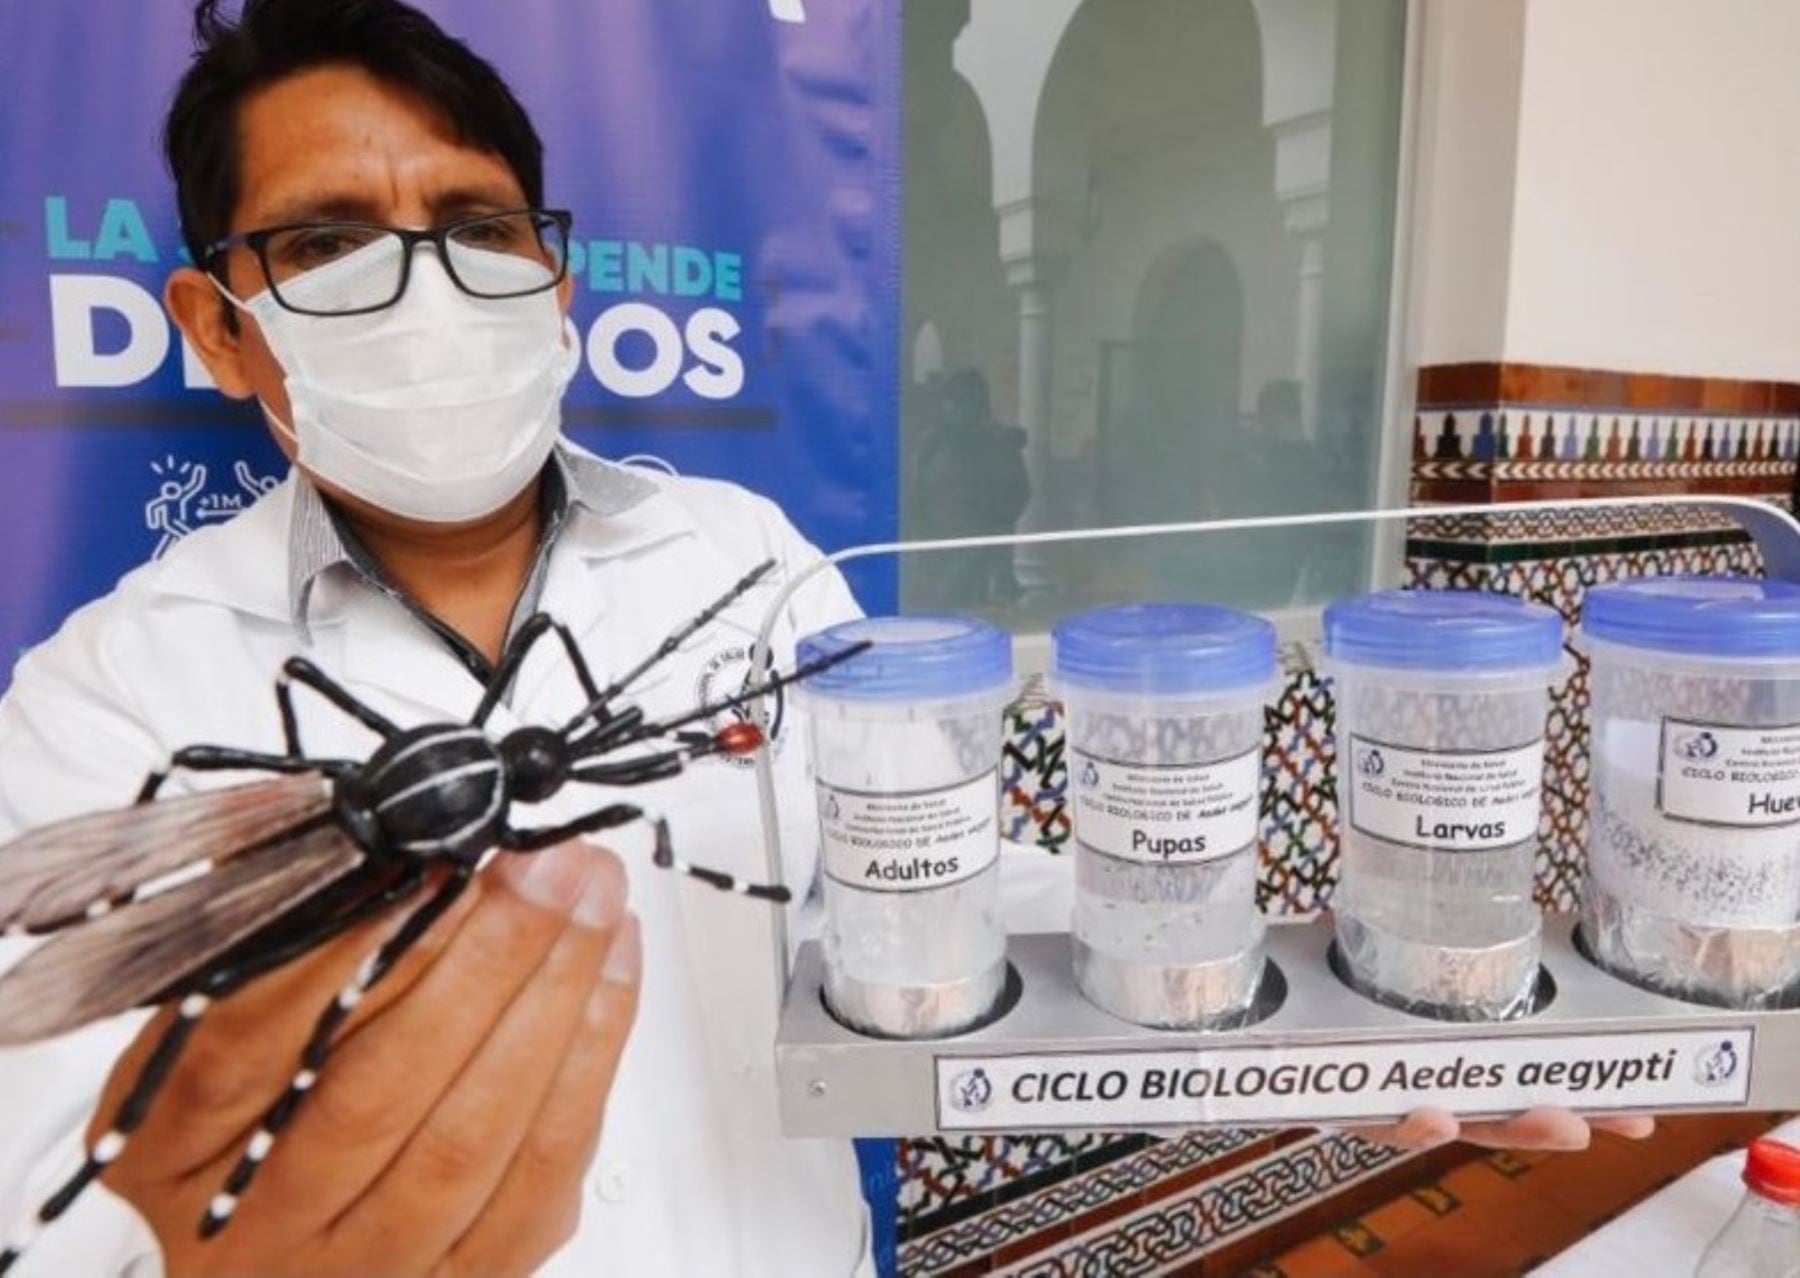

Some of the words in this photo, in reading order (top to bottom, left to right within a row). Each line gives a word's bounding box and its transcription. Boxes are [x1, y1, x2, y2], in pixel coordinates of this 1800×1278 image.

[45, 196, 160, 262] LA
[1416, 815, 1506, 839] Larvas
[1132, 829, 1206, 859] Pupas
[865, 857, 959, 880] Adultos
[1011, 1070, 1128, 1102] CICLO
[1140, 1062, 1370, 1100] BIOLOGICO
[1380, 1056, 1506, 1092] Aedes
[1517, 1048, 1678, 1091] aegypti
